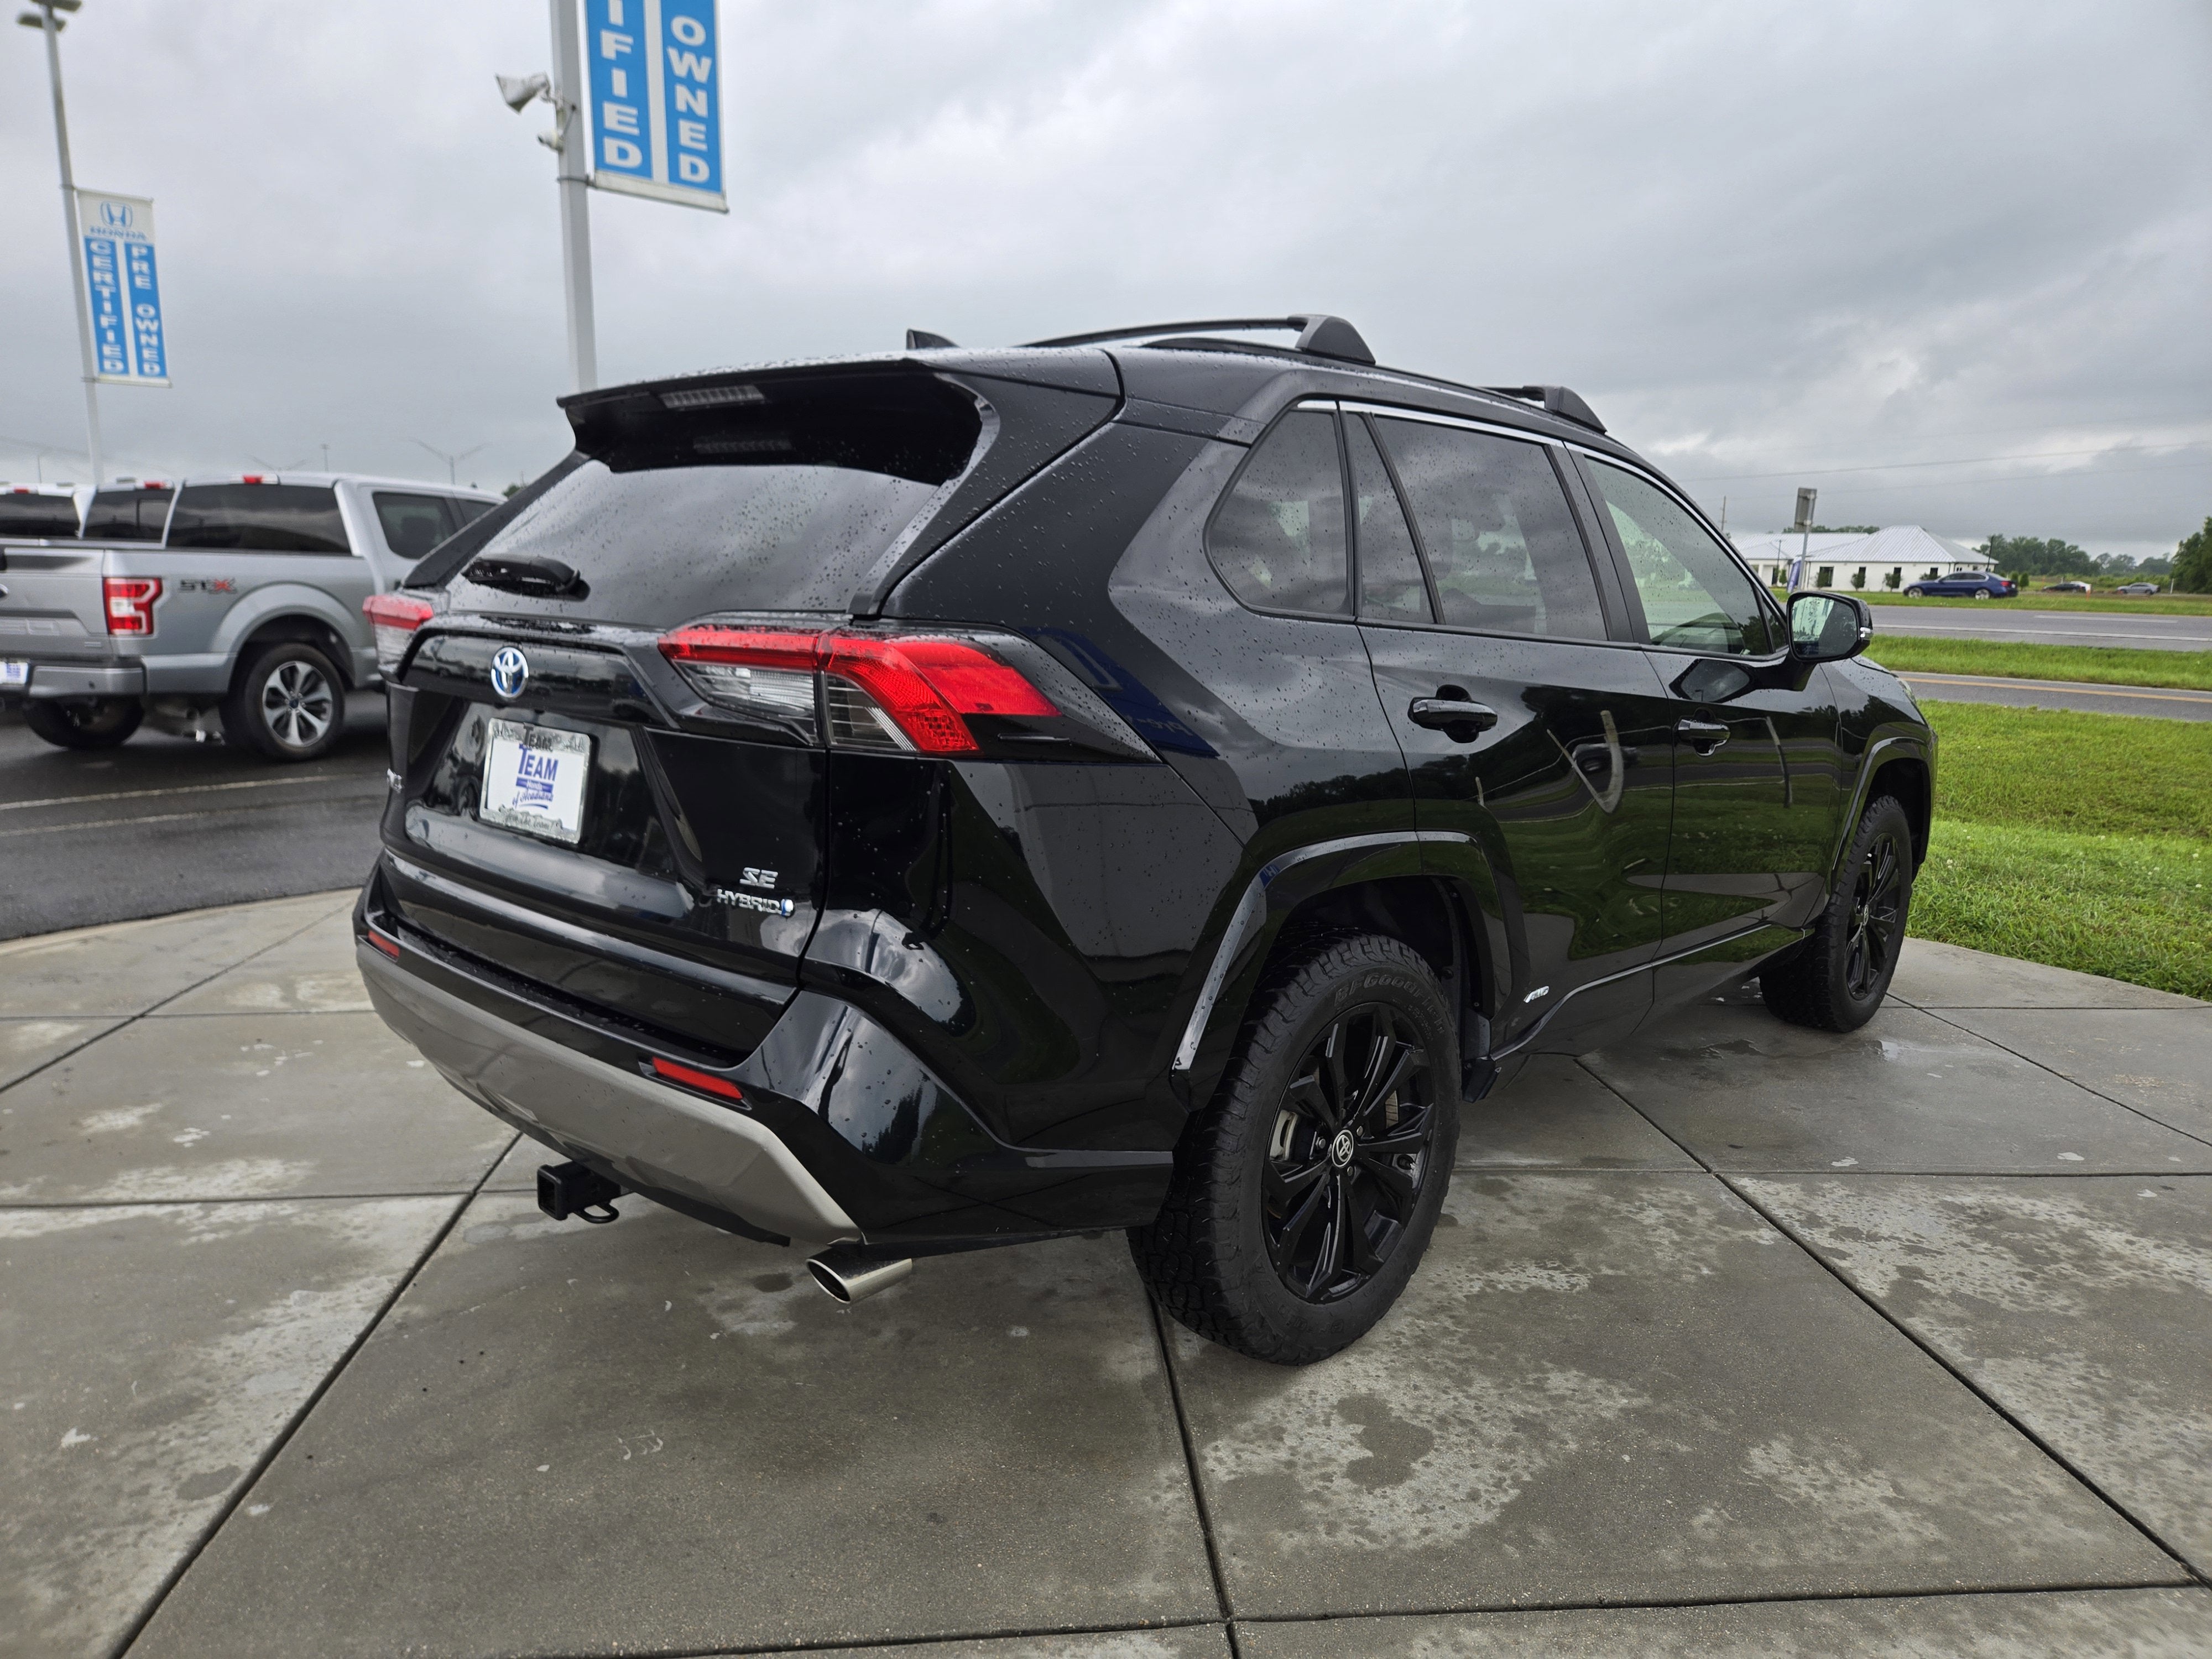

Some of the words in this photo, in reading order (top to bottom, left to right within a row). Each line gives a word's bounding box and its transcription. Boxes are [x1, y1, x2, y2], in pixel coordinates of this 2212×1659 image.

[600, 0, 643, 168] IFIED
[666, 15, 712, 182] OWNED
[131, 244, 152, 290] PRE
[90, 240, 124, 373] CERTIFIED
[135, 304, 160, 375] OWNED
[518, 743, 559, 782] TEAM
[717, 889, 782, 915] HYBRID
[739, 867, 779, 889] SE
